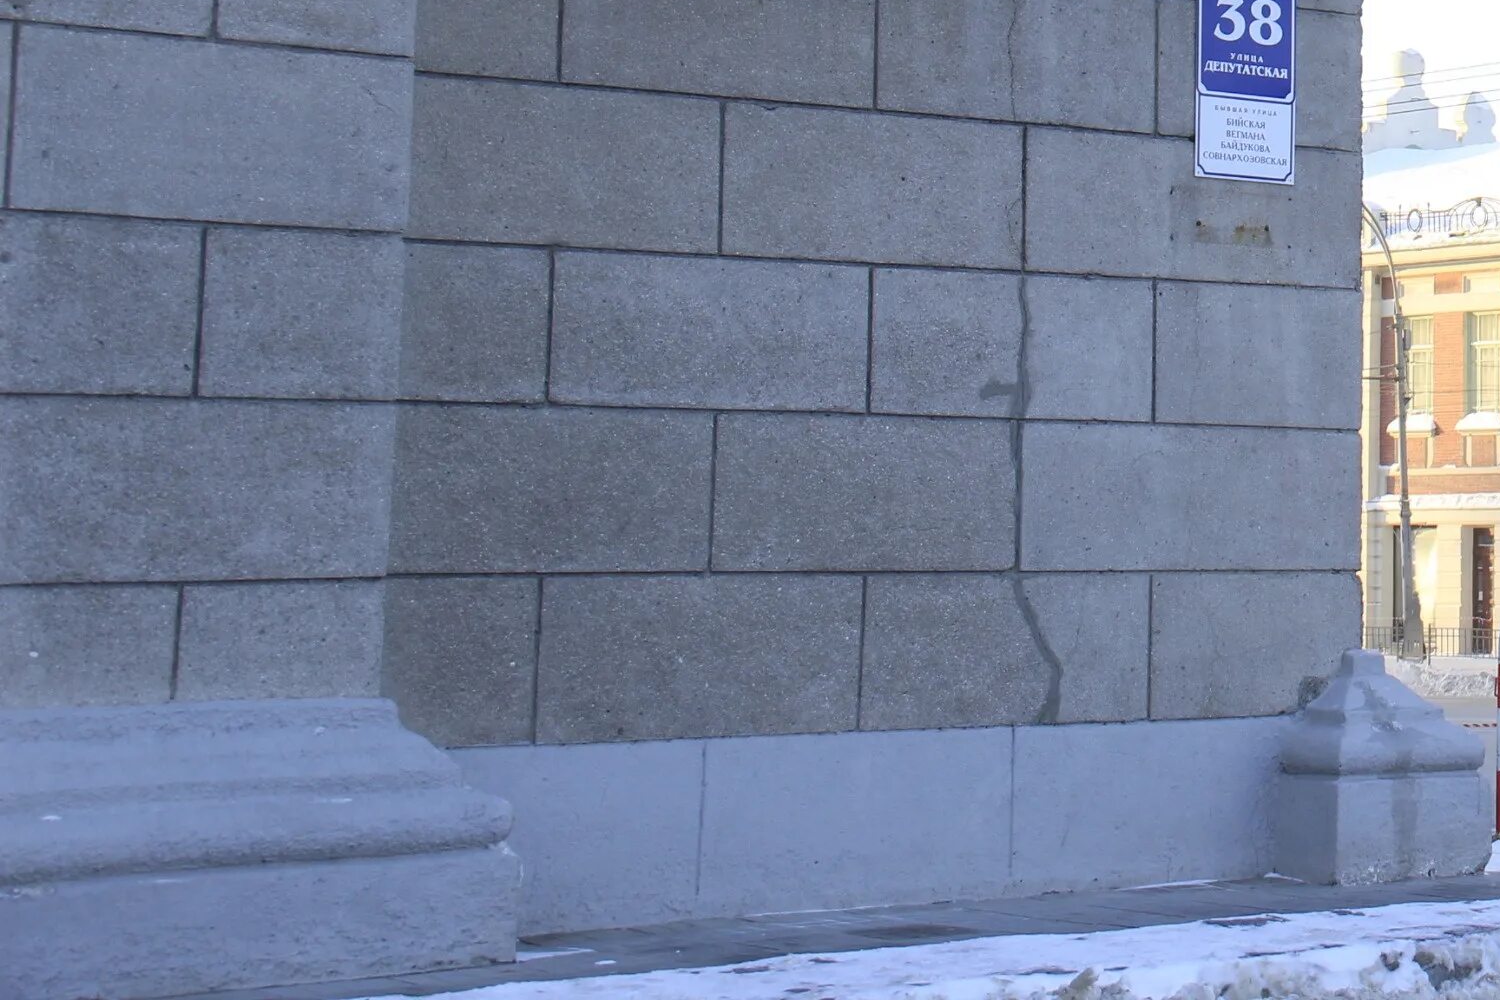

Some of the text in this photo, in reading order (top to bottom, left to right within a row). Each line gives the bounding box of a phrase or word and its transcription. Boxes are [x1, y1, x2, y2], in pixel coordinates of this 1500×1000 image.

[1230, 52, 1264, 63] УЛИЦА
[1203, 60, 1288, 79] ДЕПУТАТСКАЯ
[1214, 105, 1248, 113] БЫВШАЯ
[1226, 117, 1266, 129] БИЙСКАЯ
[1226, 129, 1266, 141] ВЕГМАНА
[1220, 140, 1271, 153] БАЙДУКОВА
[1203, 151, 1287, 166] СОВНАРХОЗОВСКАЯ
